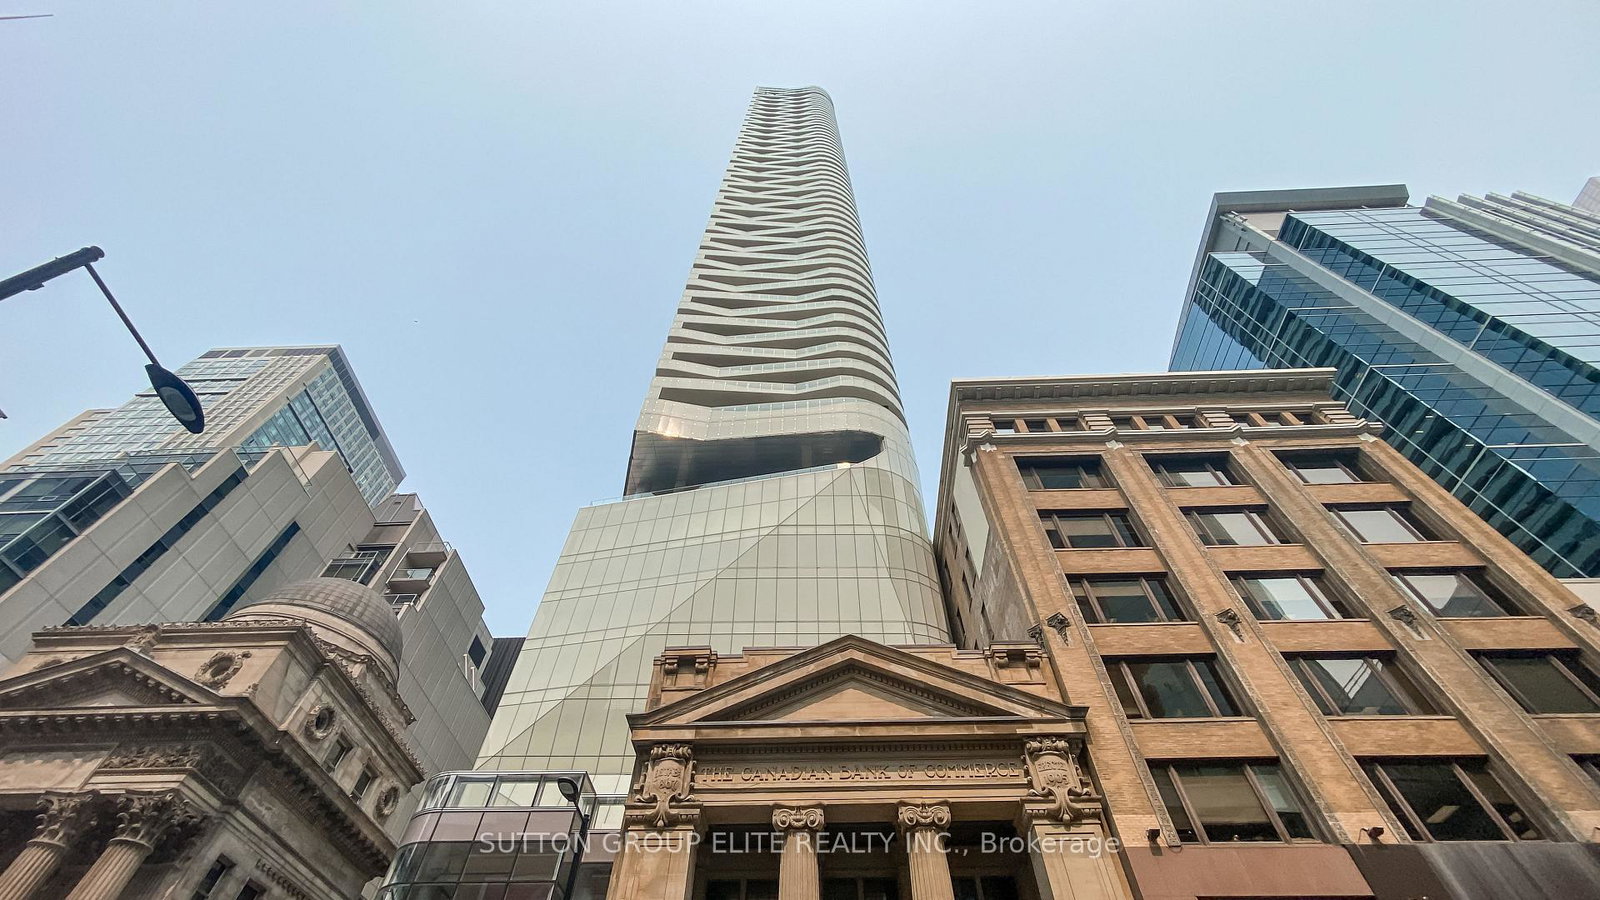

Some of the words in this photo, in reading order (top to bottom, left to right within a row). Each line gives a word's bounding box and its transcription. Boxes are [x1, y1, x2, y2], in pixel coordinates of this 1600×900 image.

[702, 766, 733, 782] THE
[741, 765, 834, 782] CANADIAN
[839, 765, 891, 780] BANK
[897, 764, 917, 779] OF
[925, 762, 1020, 778] COMMERCE
